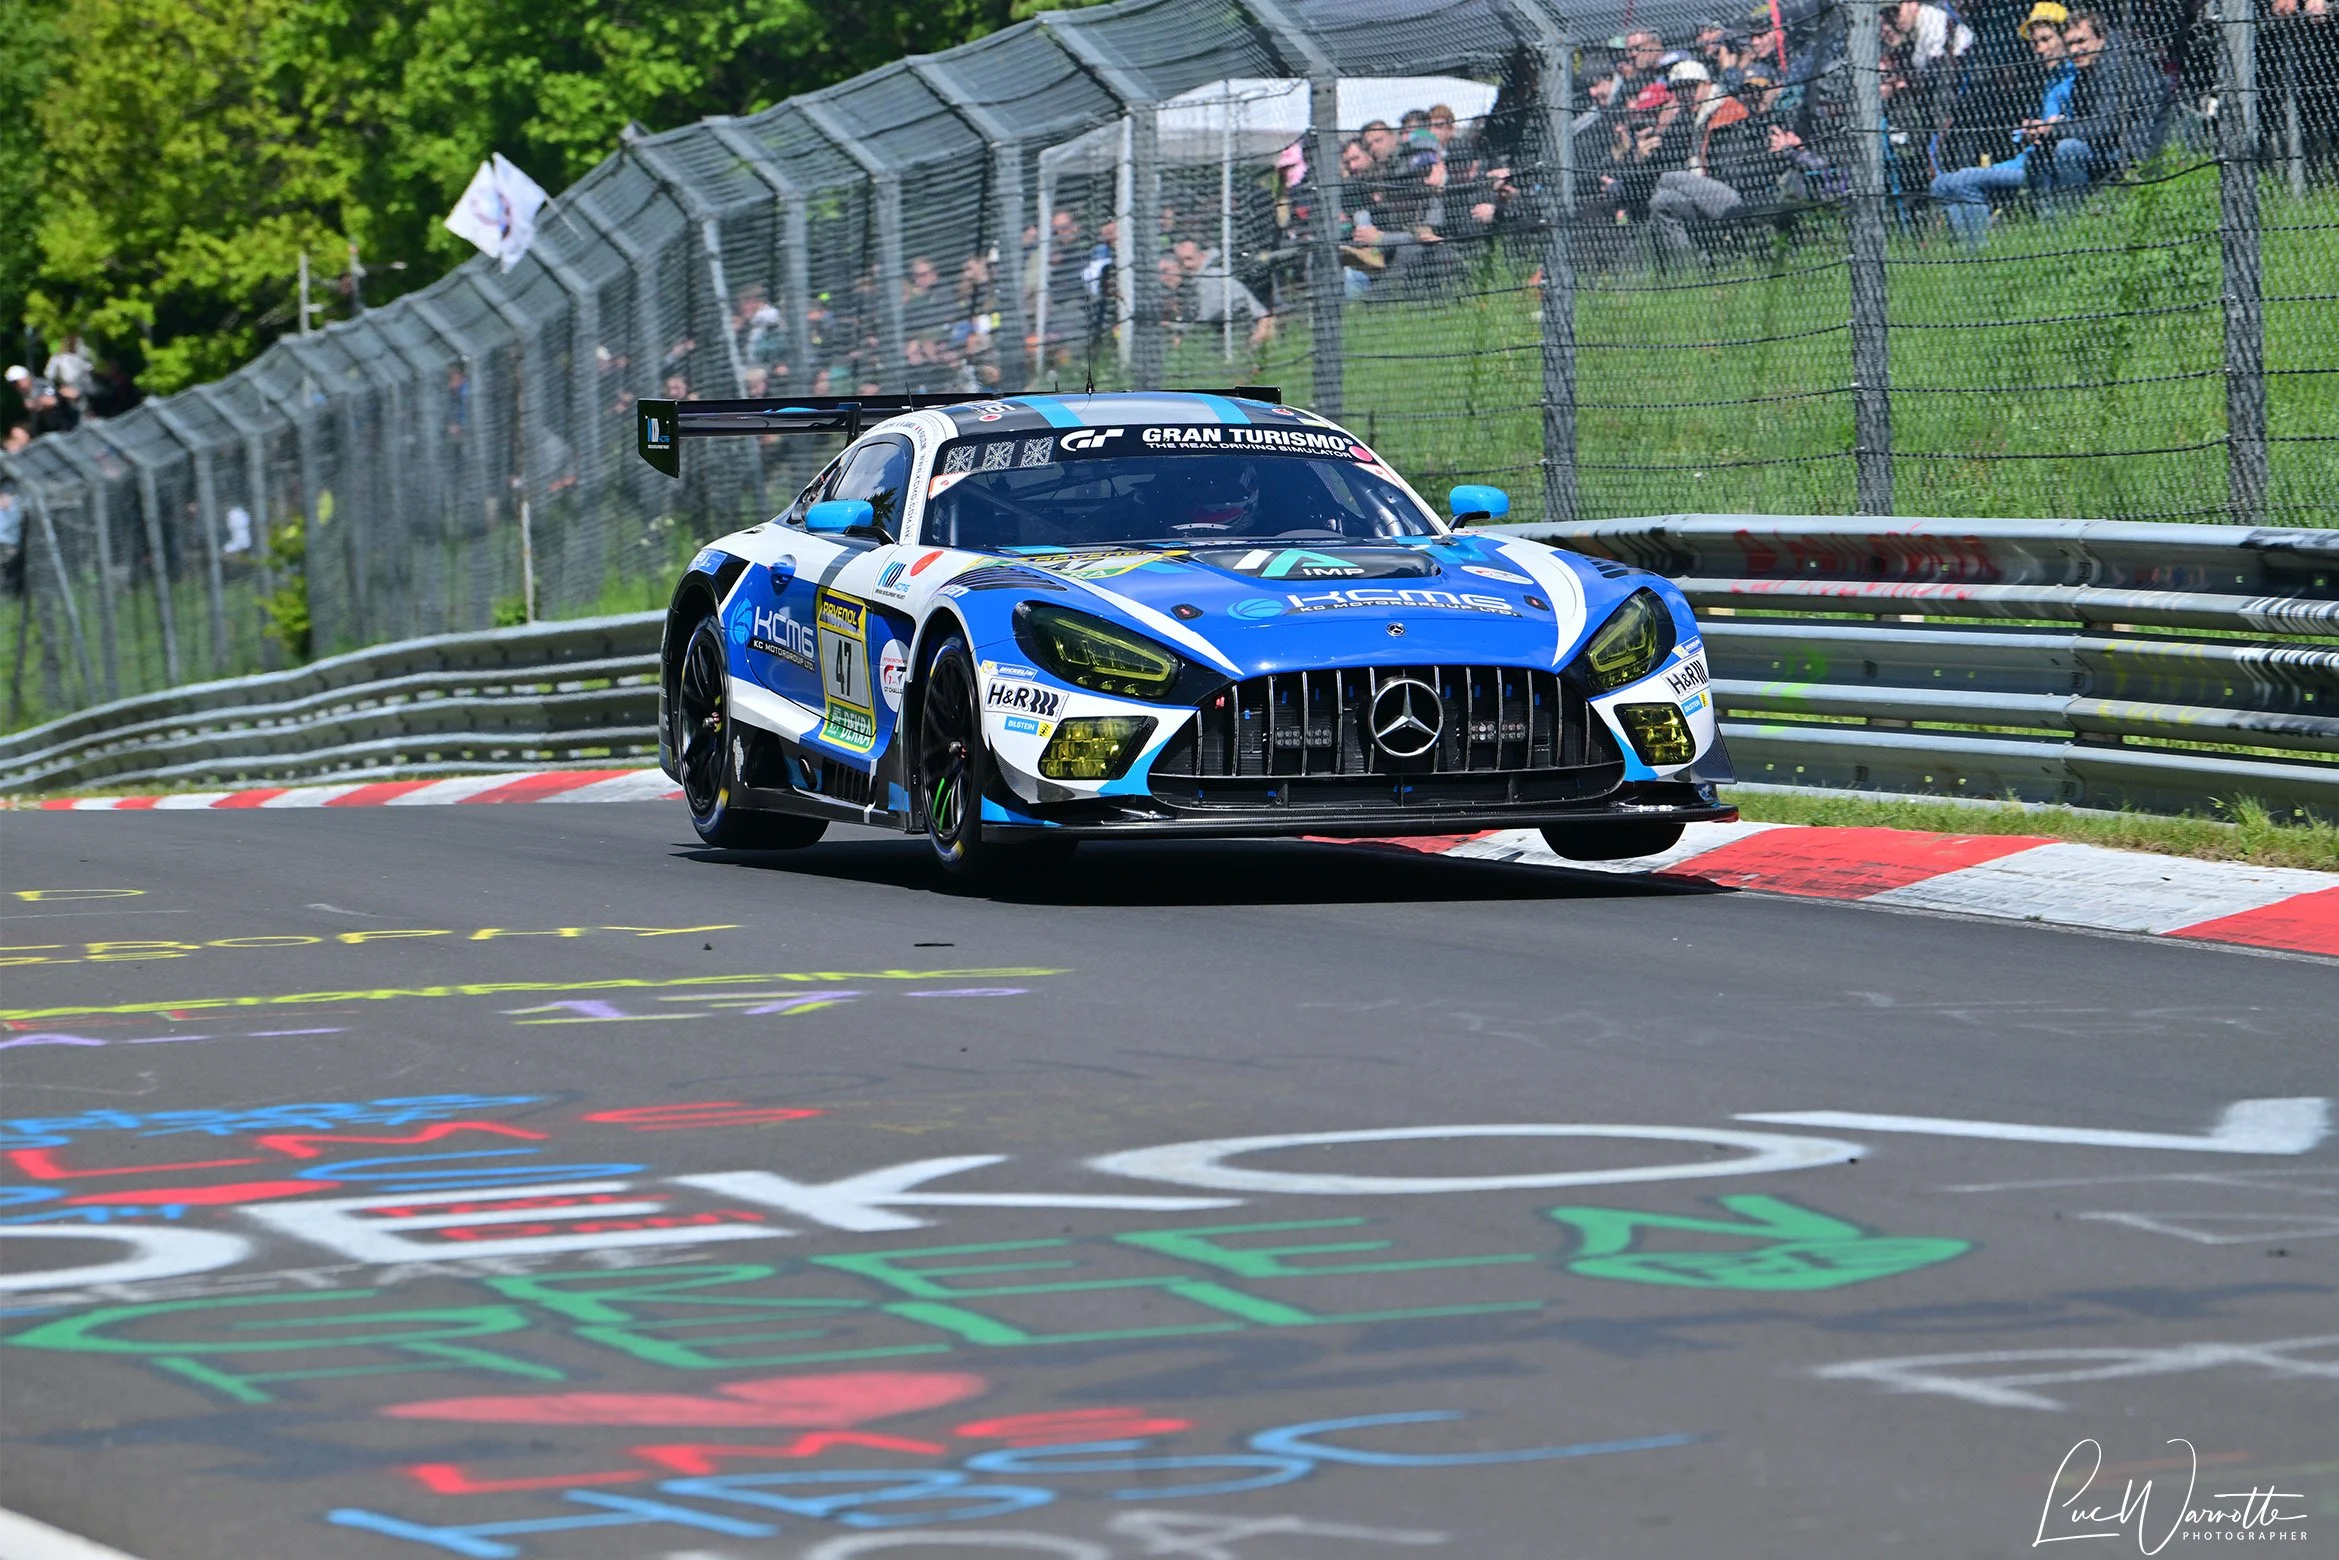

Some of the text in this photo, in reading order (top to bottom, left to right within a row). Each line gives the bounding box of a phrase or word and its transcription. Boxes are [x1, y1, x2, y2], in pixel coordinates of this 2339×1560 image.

[1141, 427, 1225, 444] GRAN
[1221, 443, 1275, 451] DRIVING
[1279, 445, 1353, 459] SIMULATOR
[1300, 567, 1366, 577] IMP
[823, 601, 858, 626] RAVENOL
[1334, 600, 1472, 611] MOTORGROUP
[1478, 607, 1520, 617] LTD.
[753, 606, 815, 660] KCMG
[753, 639, 815, 672] KC MOTORGROUP LTD.
[835, 639, 852, 697] 47
[999, 666, 1035, 677] MICHELIN
[1666, 665, 1700, 695] H&R
[988, 683, 1030, 708] H&R
[1007, 720, 1035, 731] BILSTEIN
